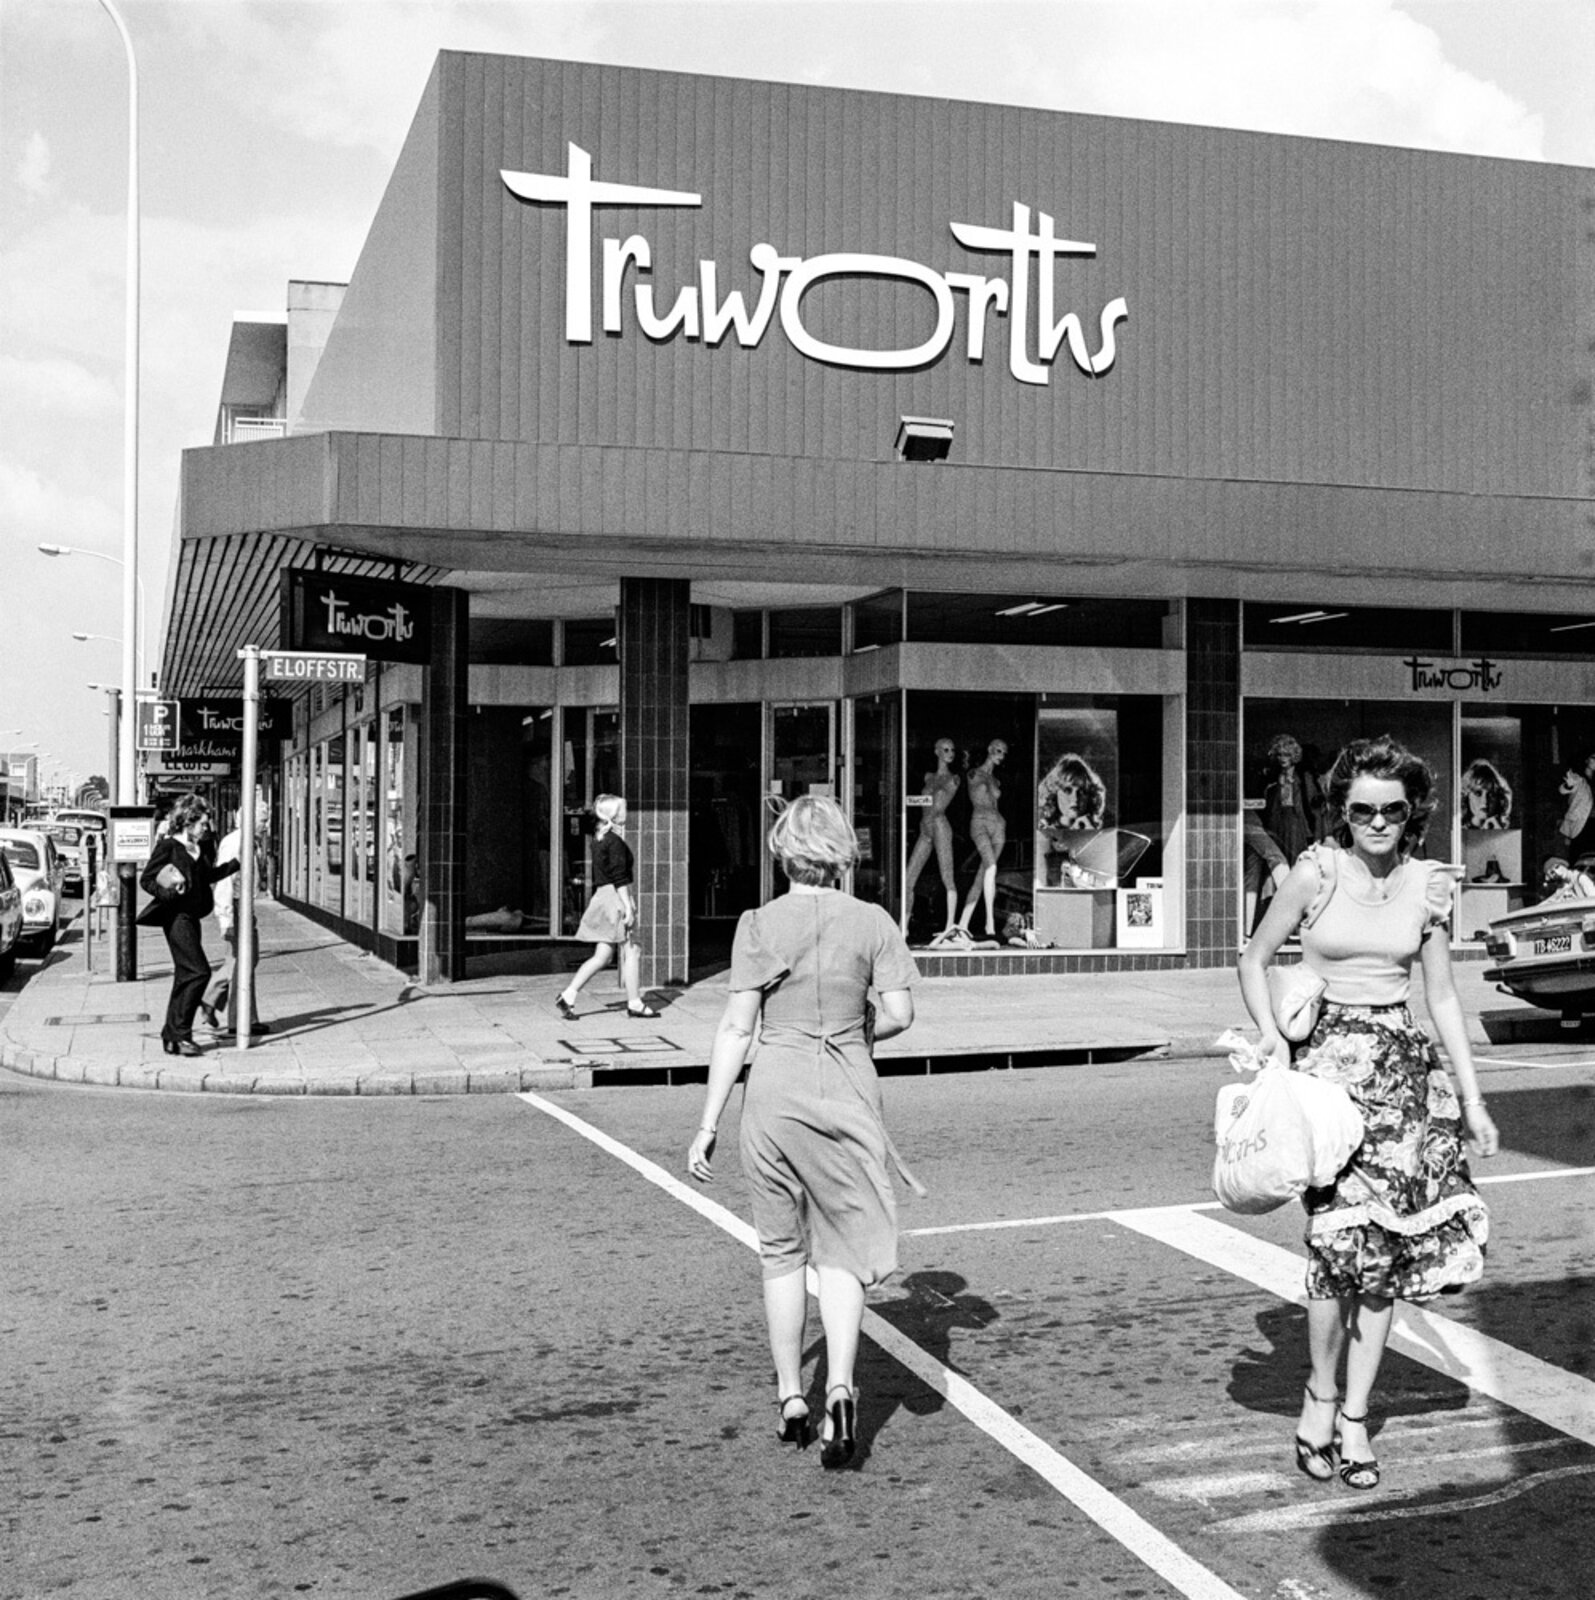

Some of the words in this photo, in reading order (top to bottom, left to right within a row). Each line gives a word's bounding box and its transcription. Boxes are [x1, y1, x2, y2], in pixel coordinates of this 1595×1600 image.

[499, 141, 1128, 385] Truworths
[320, 589, 414, 642] Truworths
[1403, 656, 1503, 692] Truworths
[153, 705, 169, 724] P
